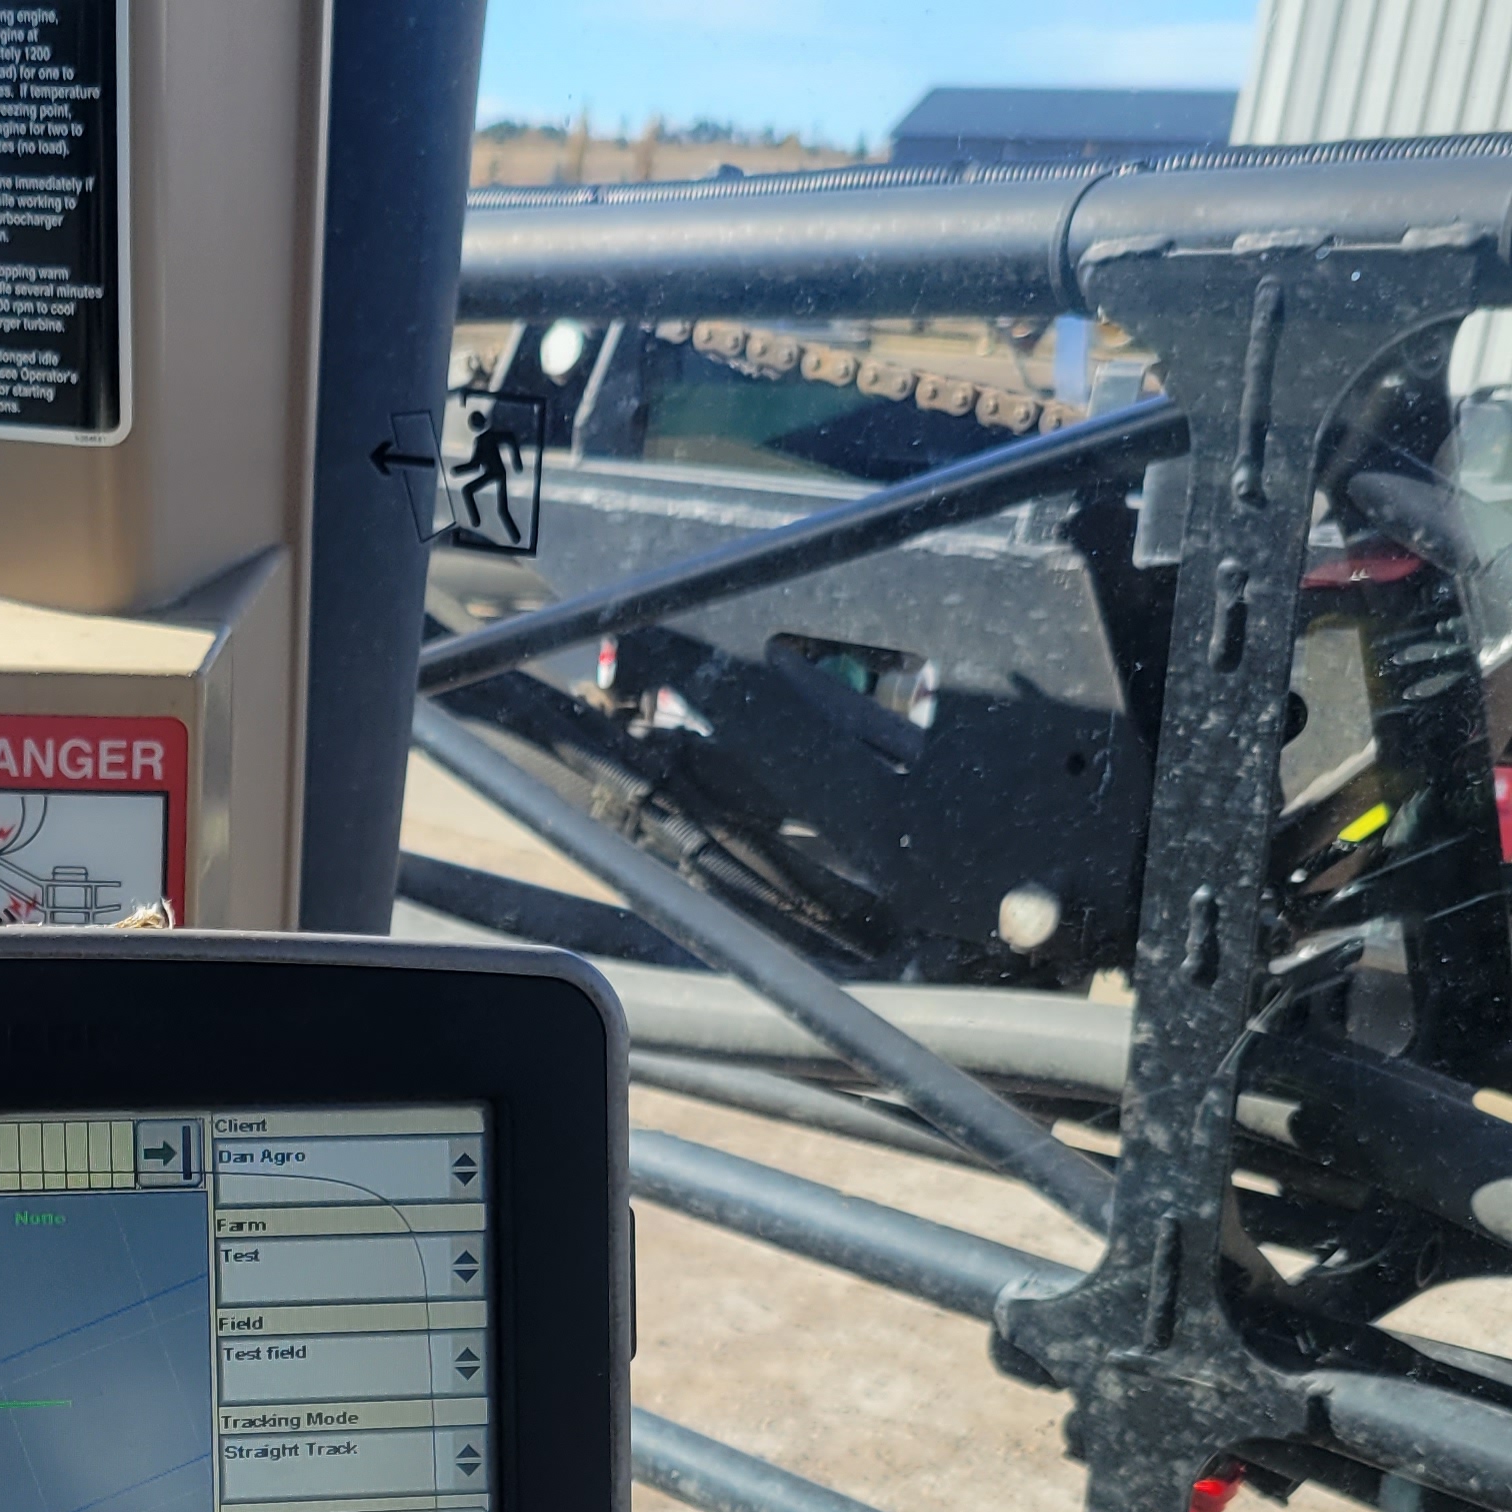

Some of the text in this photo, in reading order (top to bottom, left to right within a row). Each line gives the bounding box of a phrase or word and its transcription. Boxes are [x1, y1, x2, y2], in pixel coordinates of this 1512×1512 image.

[17, 9, 59, 26] engine,
[27, 28, 38, 41] at
[25, 47, 51, 61] 1200
[20, 66, 35, 80] for
[39, 68, 59, 80] one
[63, 67, 74, 80] to
[30, 85, 100, 102] temperature
[40, 104, 71, 120] point,
[29, 122, 45, 136] for
[48, 124, 68, 136] two
[71, 124, 83, 137] to
[18, 140, 36, 157] (no
[15, 176, 82, 194] immediately
[18, 195, 61, 211] working
[64, 196, 77, 210] to
[39, 267, 68, 280] warm
[15, 284, 54, 297] several
[57, 285, 102, 299] minutes
[13, 303, 34, 315] rpm
[37, 301, 48, 314] to
[51, 301, 74, 316] cool
[39, 349, 59, 365] idle
[0, 368, 17, 380] see
[12, 384, 54, 402] starting
[214, 1118, 267, 1133] Client
[219, 1149, 306, 1167] Dan Agro
[15, 1211, 66, 1226] None
[217, 1218, 266, 1232] Farm
[222, 1249, 260, 1263] Test
[219, 1317, 263, 1331] Field
[224, 1345, 306, 1361] Test field
[222, 1411, 358, 1429] Tracking Mode
[224, 1442, 358, 1460] Straight Track
